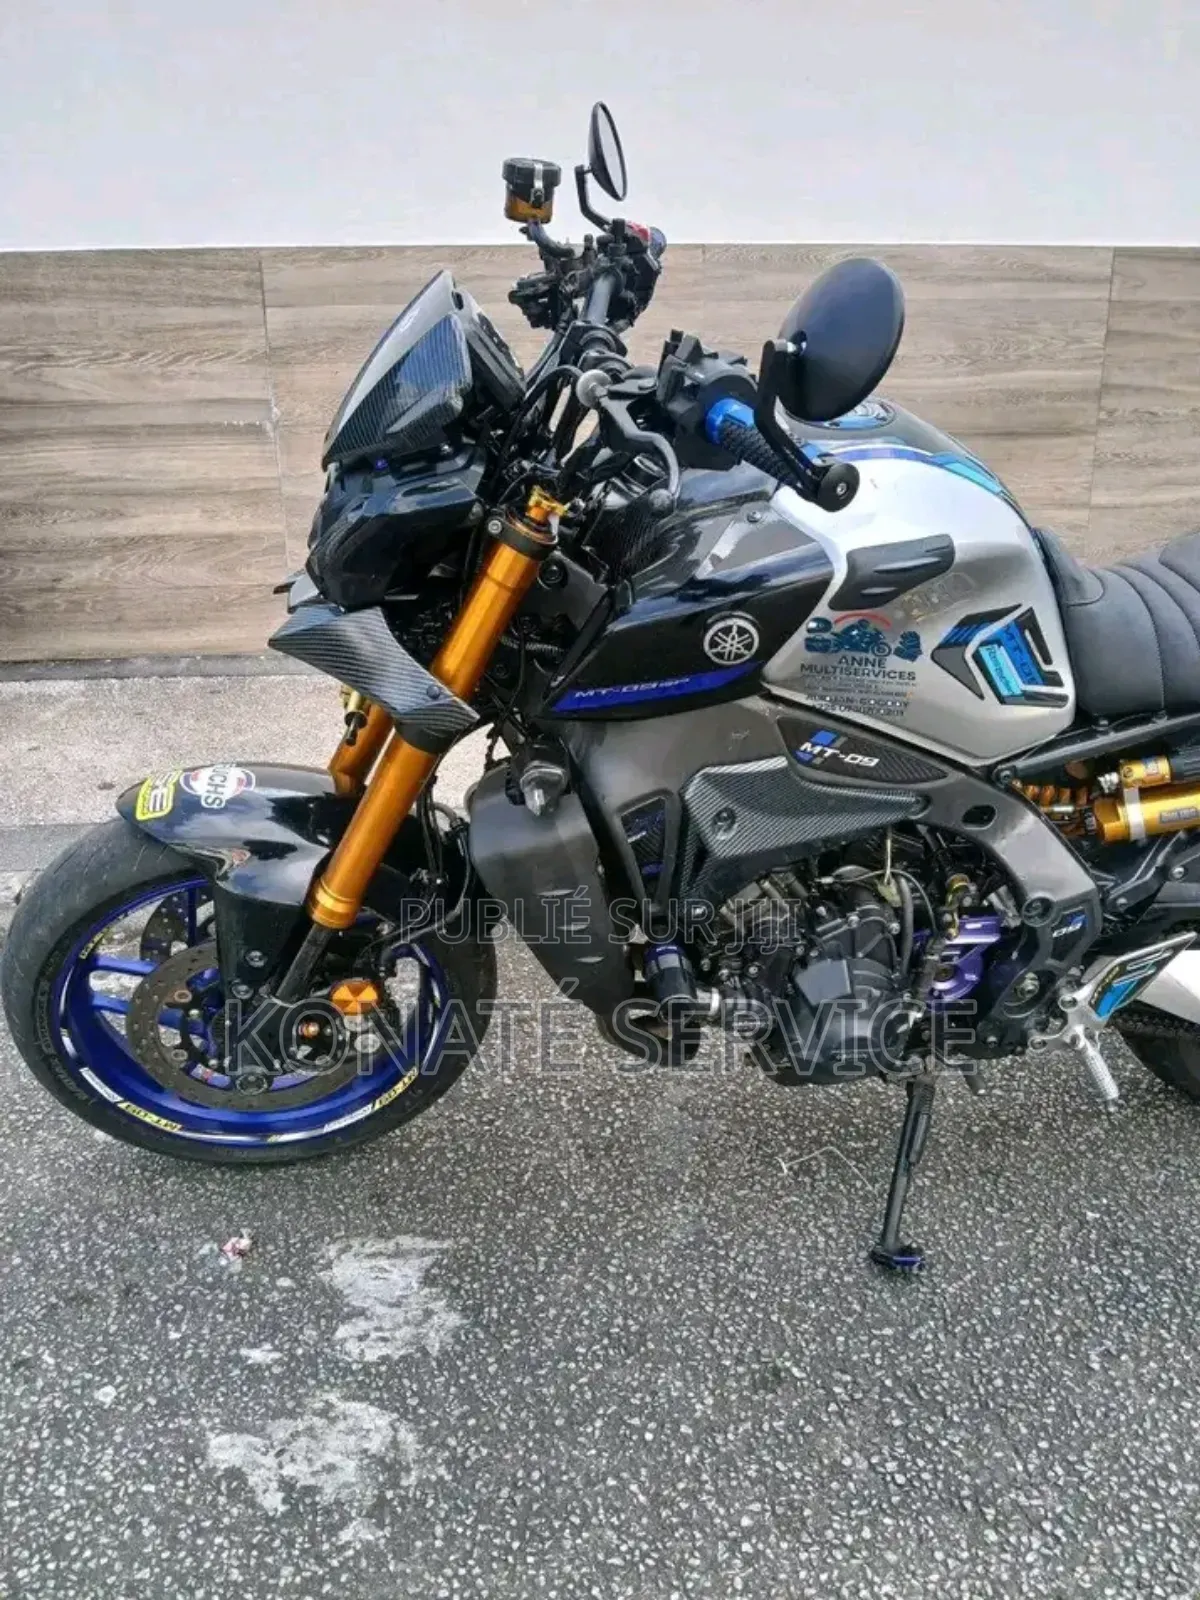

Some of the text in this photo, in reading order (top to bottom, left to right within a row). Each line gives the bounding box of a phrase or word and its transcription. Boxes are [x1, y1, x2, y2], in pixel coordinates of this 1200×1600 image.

[838, 655, 887, 669] ANNE
[800, 663, 917, 681] MULTISERVICES
[800, 741, 880, 767] MT-09
